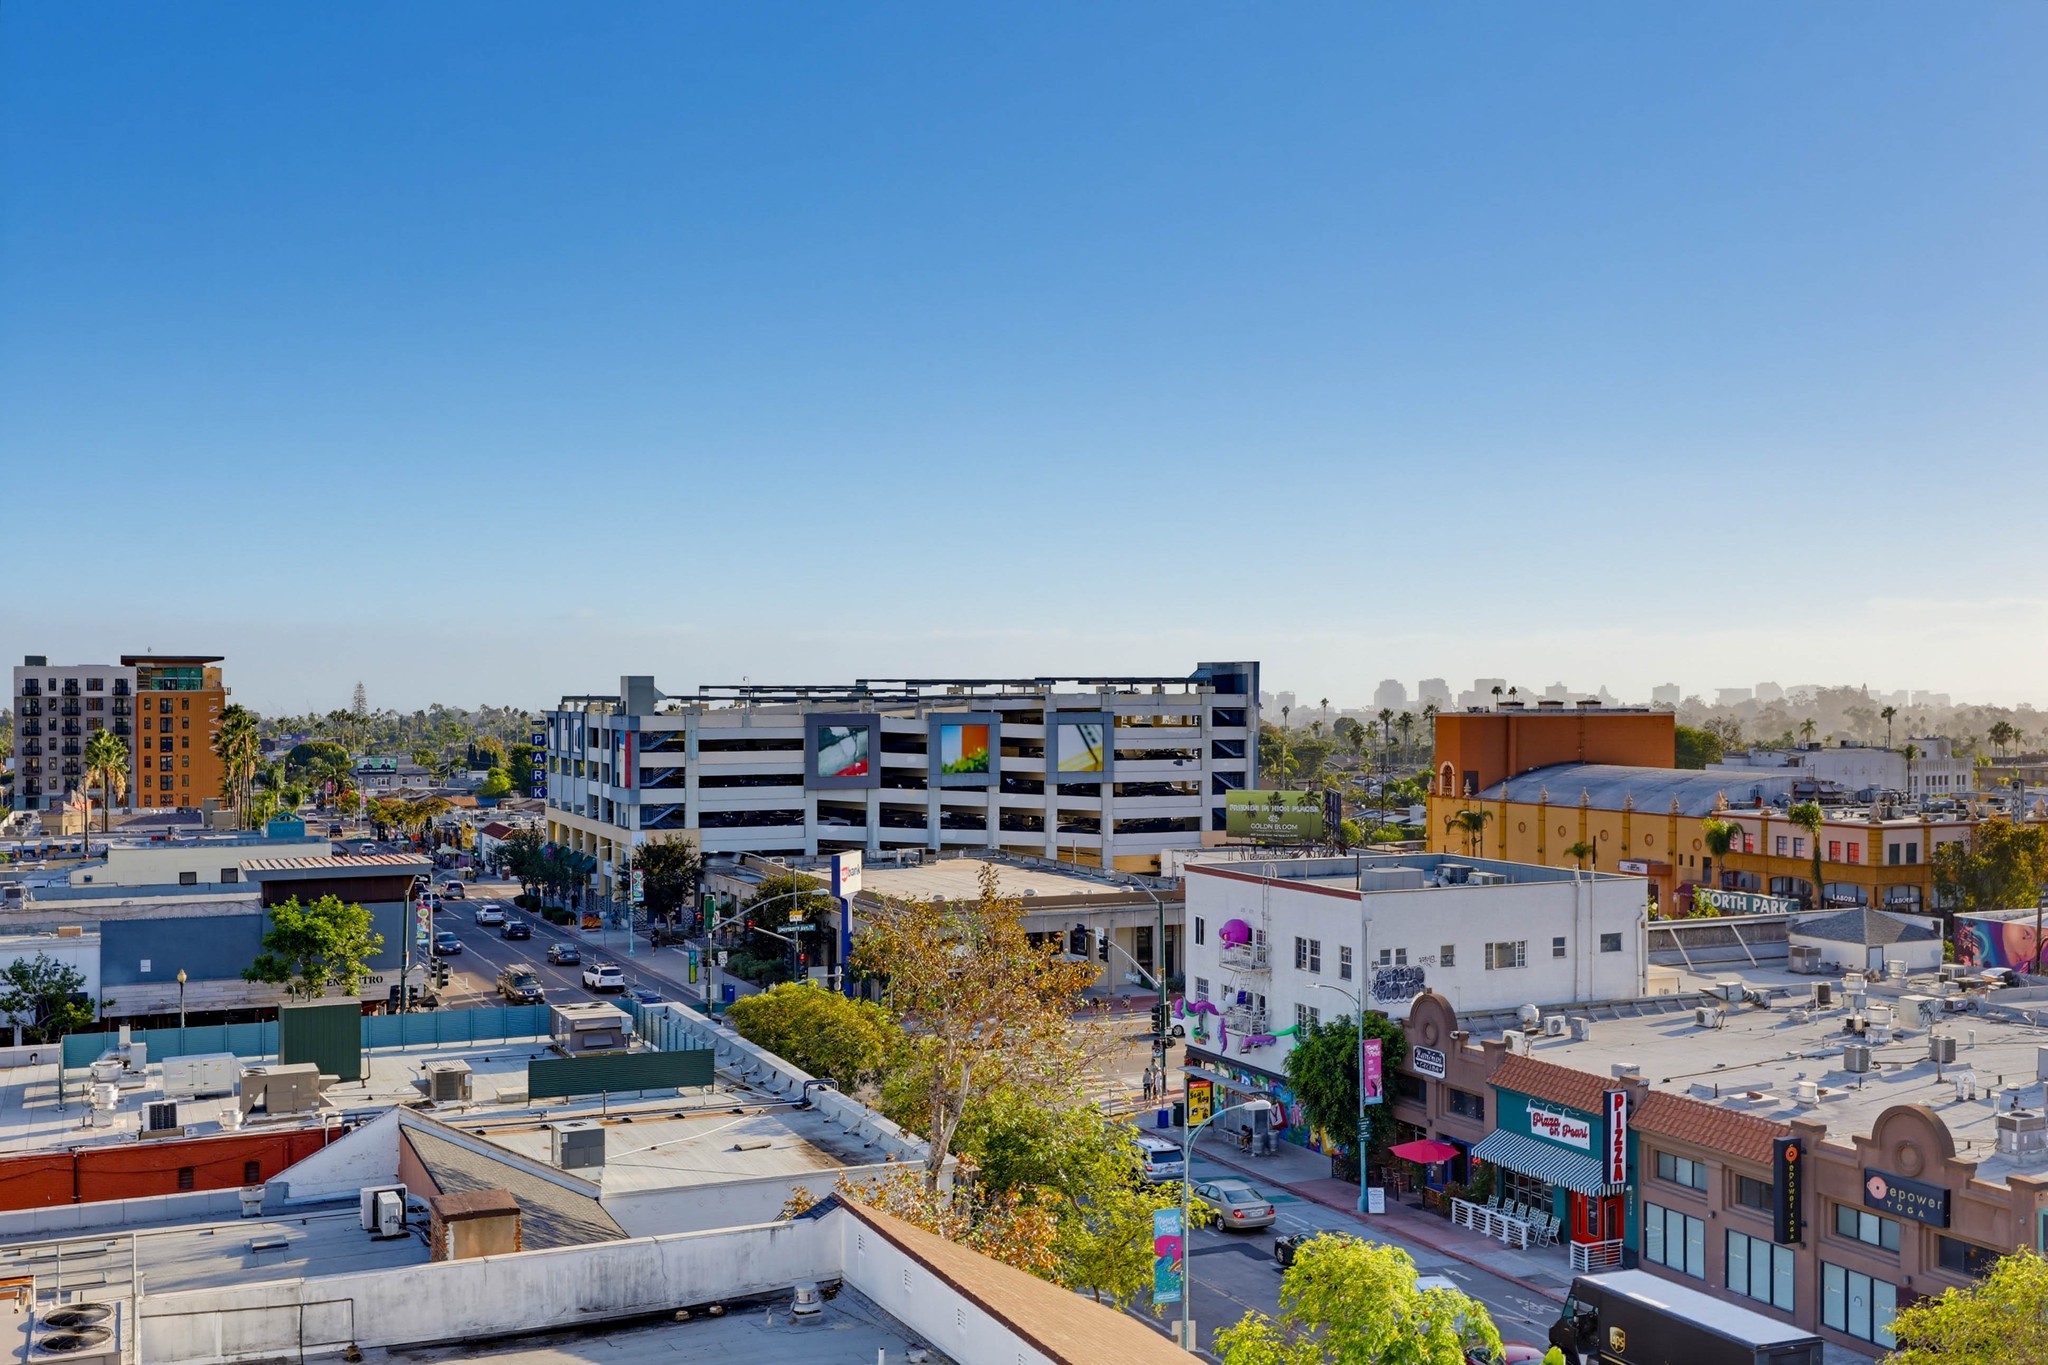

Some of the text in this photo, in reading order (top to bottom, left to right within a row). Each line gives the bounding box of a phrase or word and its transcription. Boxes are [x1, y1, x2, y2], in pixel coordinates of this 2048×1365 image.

[534, 735, 543, 798] PARK
[1752, 897, 1789, 914] PARK
[1532, 1112, 1561, 1128] Pizza
[1562, 1124, 1588, 1139] Pearl
[1613, 1093, 1624, 1182] PIZZA
[1886, 1200, 1924, 1218] YOGA
